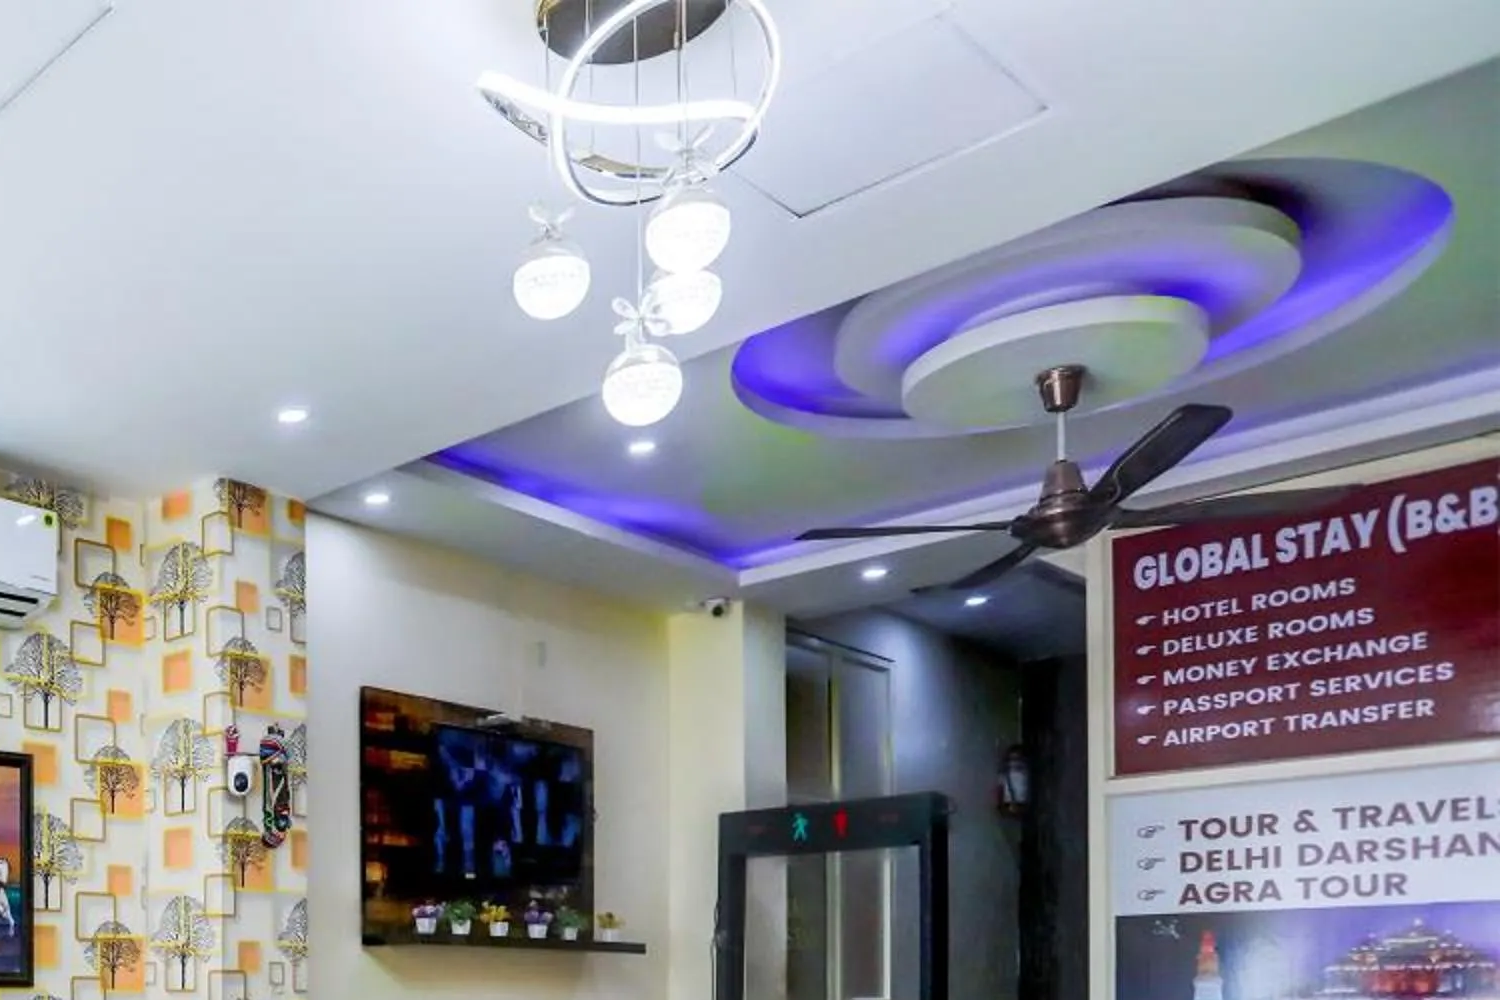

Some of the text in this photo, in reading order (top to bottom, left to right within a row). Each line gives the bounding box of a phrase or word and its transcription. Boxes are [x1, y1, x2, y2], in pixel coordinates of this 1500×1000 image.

[1133, 486, 1500, 590] GLOBAL STAY (B&B
[1161, 578, 1355, 626] HOTEL ROOMS
[1162, 607, 1373, 656] DELUXE ROOMS
[1162, 631, 1427, 686] MONEY EXCHANGE
[1162, 662, 1455, 716] PASSPORT SERVICES
[1161, 699, 1434, 747] AIRPORT TRANSFER
[1178, 796, 1500, 841] TOUR & TRAVEL
[1179, 832, 1500, 874] DELHI DARSHAN
[1178, 873, 1407, 905] AGRA TOUR
